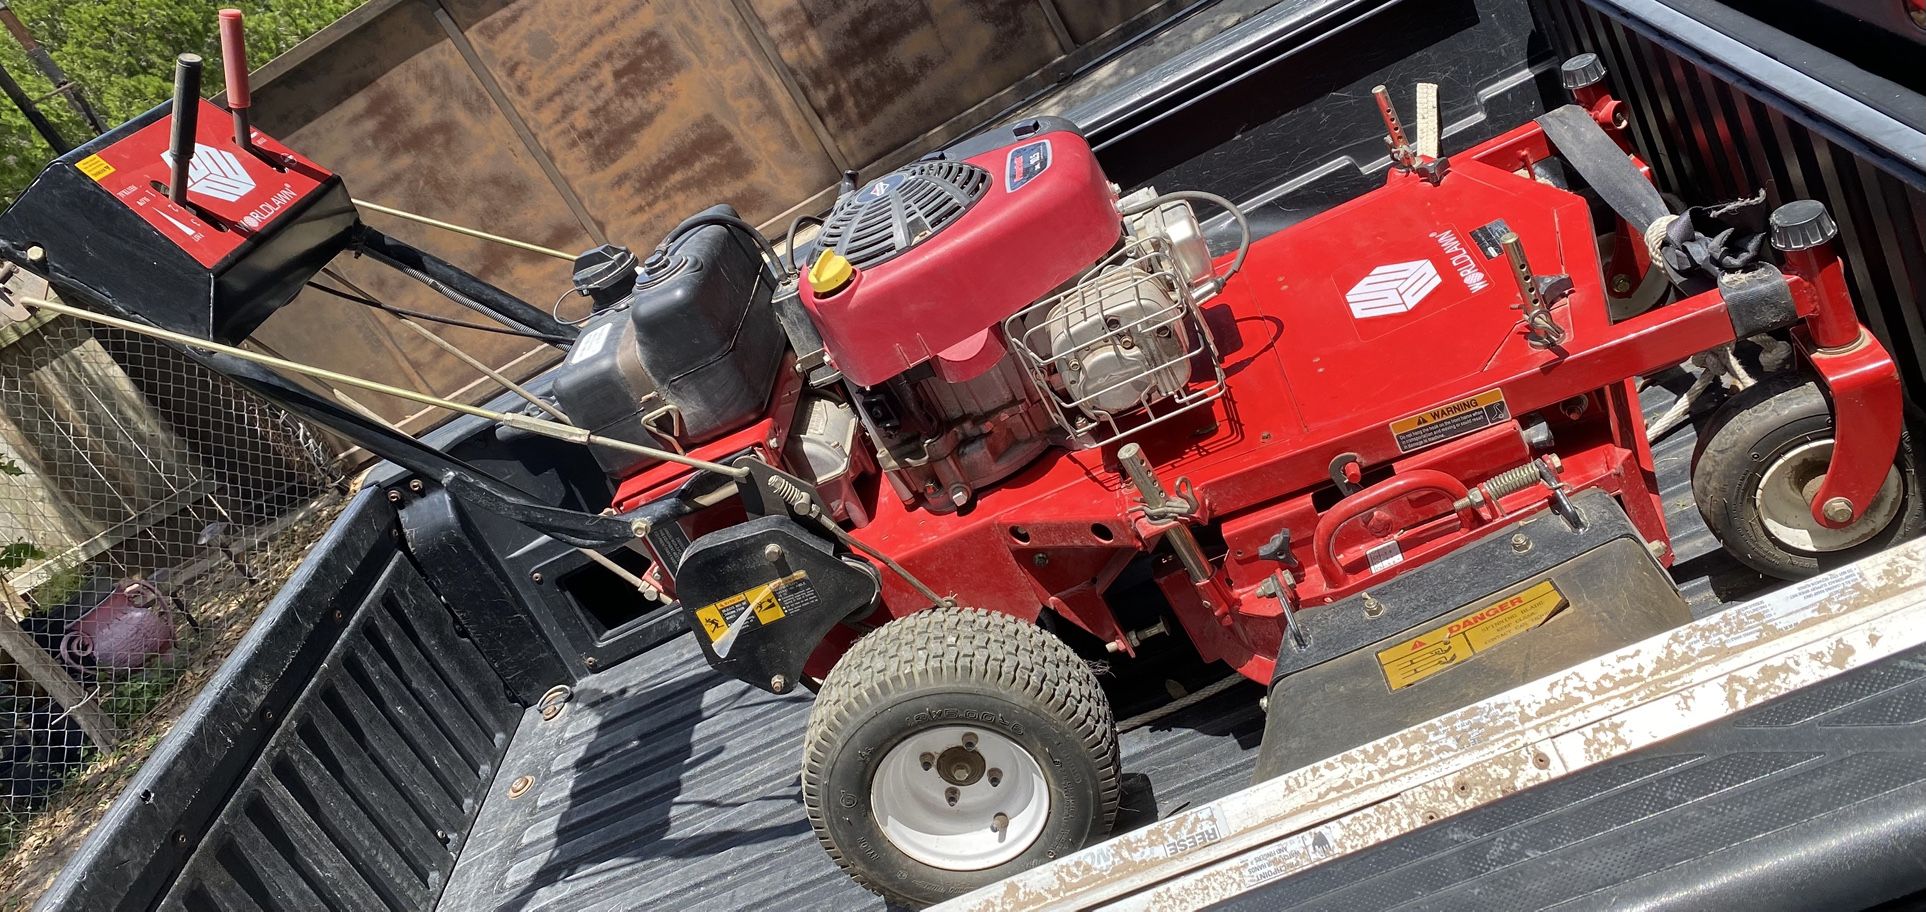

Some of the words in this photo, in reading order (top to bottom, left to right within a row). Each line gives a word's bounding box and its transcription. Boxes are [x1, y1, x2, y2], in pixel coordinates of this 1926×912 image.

[233, 186, 298, 233] WORLDLAWN
[1435, 229, 1489, 294] WORLDLAWN
[1429, 397, 1479, 421] WARNING
[1445, 595, 1525, 635] DANGER
[1164, 826, 1219, 856] REESE
[1274, 844, 1288, 855] AND
[1246, 862, 1267, 875] HANDS
